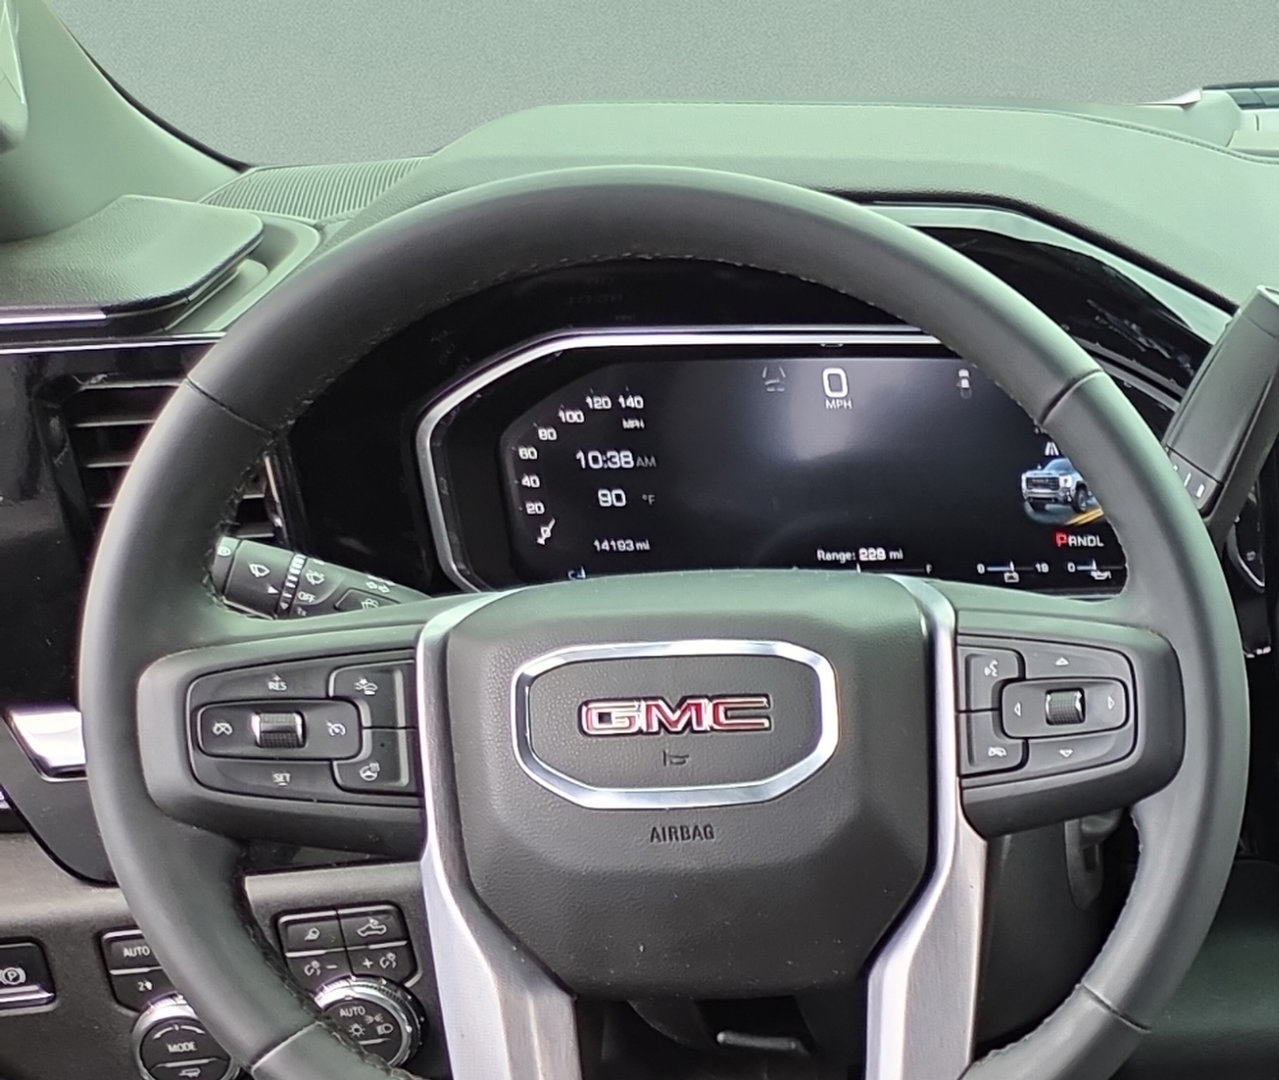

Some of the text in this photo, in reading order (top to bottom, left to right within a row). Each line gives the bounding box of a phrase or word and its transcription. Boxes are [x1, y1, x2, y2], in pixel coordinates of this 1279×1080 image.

[822, 367, 849, 398] 0
[586, 395, 644, 409] 120 140
[825, 399, 852, 409] MPH
[558, 409, 585, 423] 100
[538, 428, 557, 441] 80
[518, 447, 538, 460] 60
[576, 450, 657, 469] 10:38 AM
[521, 475, 540, 488] 40
[597, 489, 626, 507] 90
[526, 502, 545, 515] 20
[816, 549, 856, 564] Range:
[889, 548, 904, 560] mi
[267, 681, 287, 691] RES
[578, 694, 772, 737] GMC
[272, 772, 291, 783] SET
[649, 824, 716, 843] AIRBAG
[123, 945, 151, 958] AUTO
[339, 1005, 366, 1018] AUTO
[167, 1041, 197, 1055] MODE
